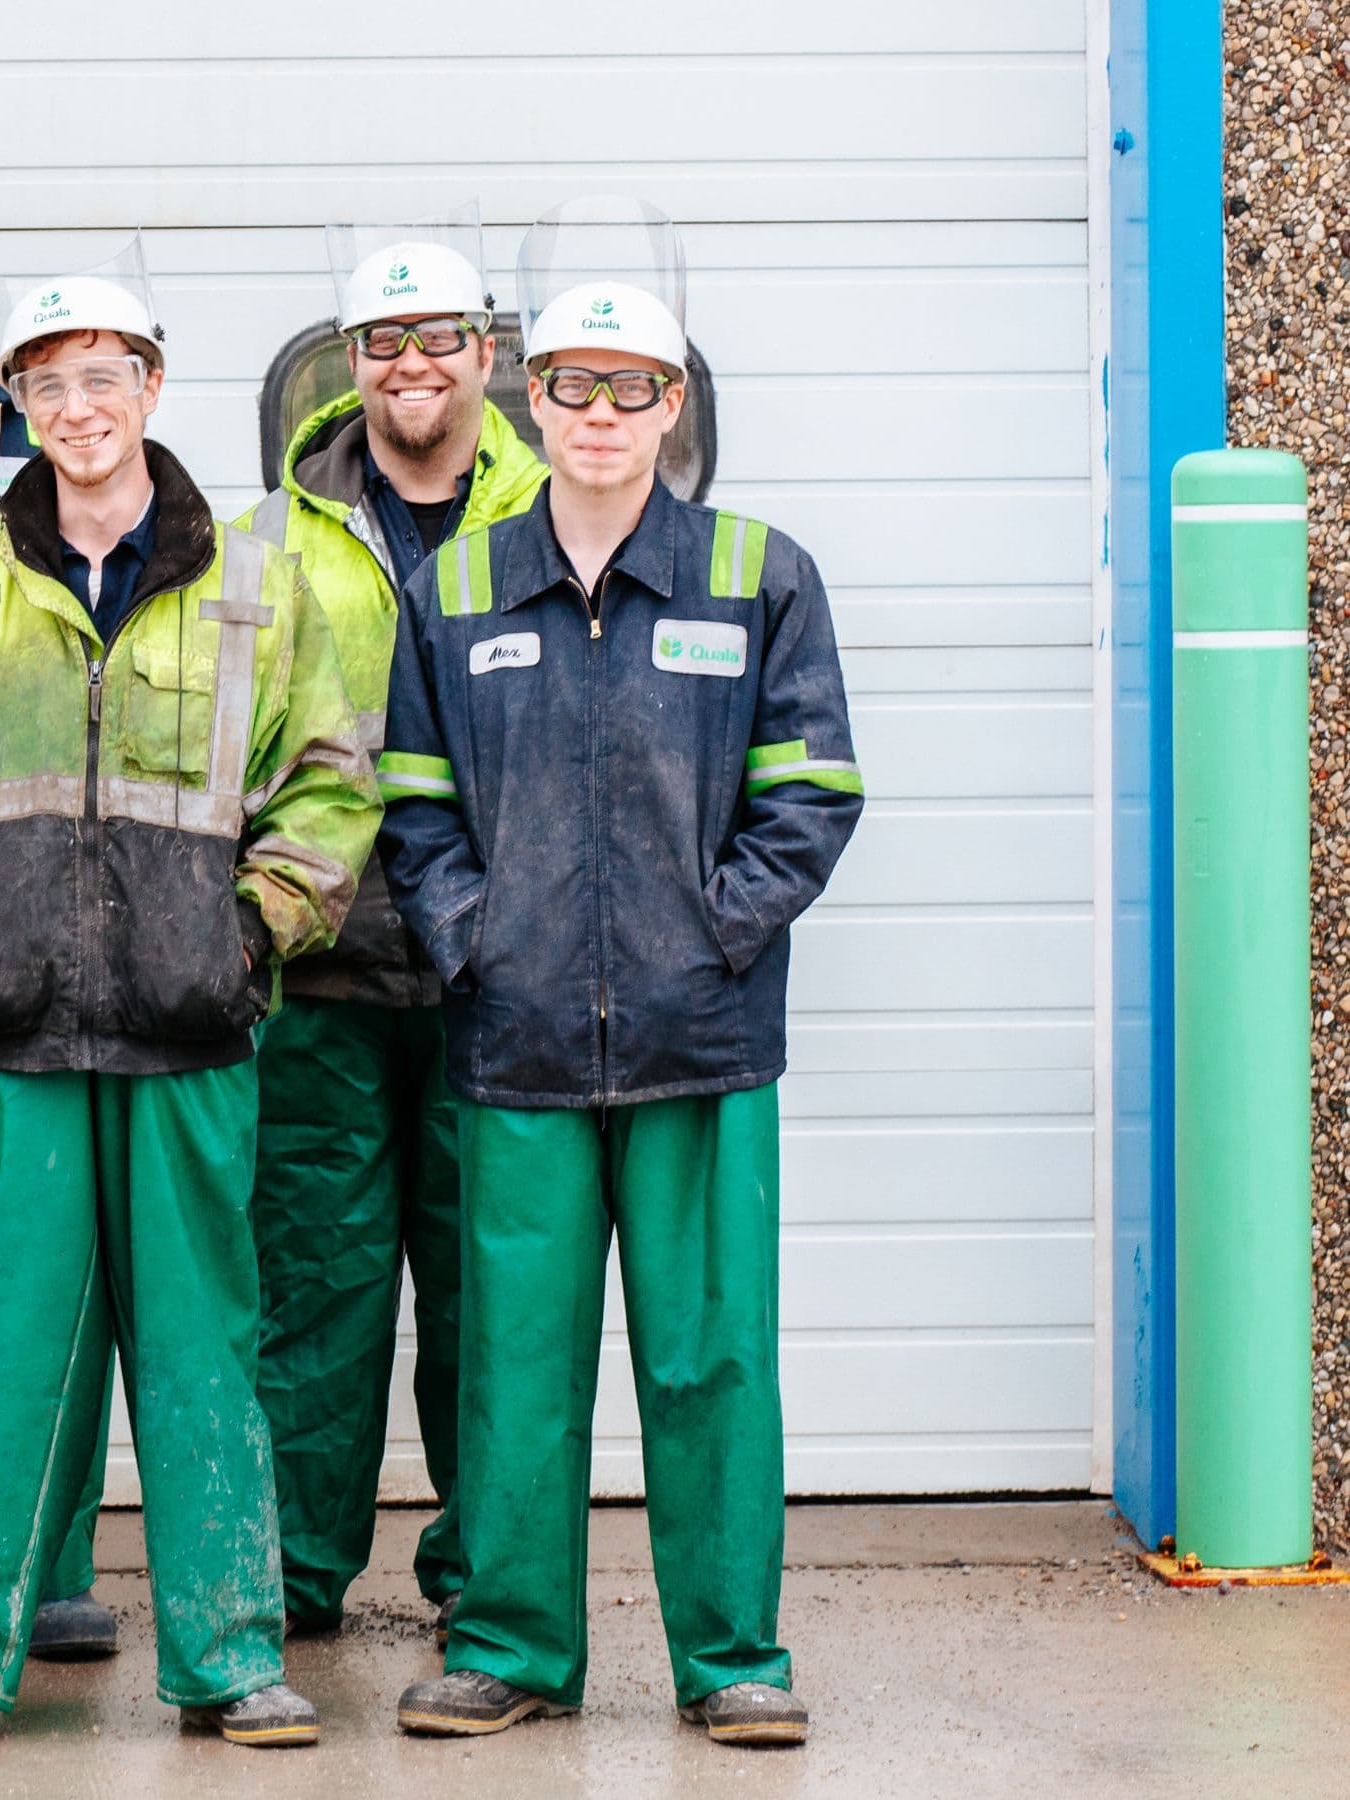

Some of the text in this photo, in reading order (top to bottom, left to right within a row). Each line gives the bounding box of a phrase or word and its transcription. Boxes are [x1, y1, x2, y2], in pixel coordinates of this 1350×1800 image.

[383, 283, 418, 297] Quala
[34, 307, 71, 324] Quala
[582, 318, 620, 330] Quala
[689, 643, 740, 664] Quala
